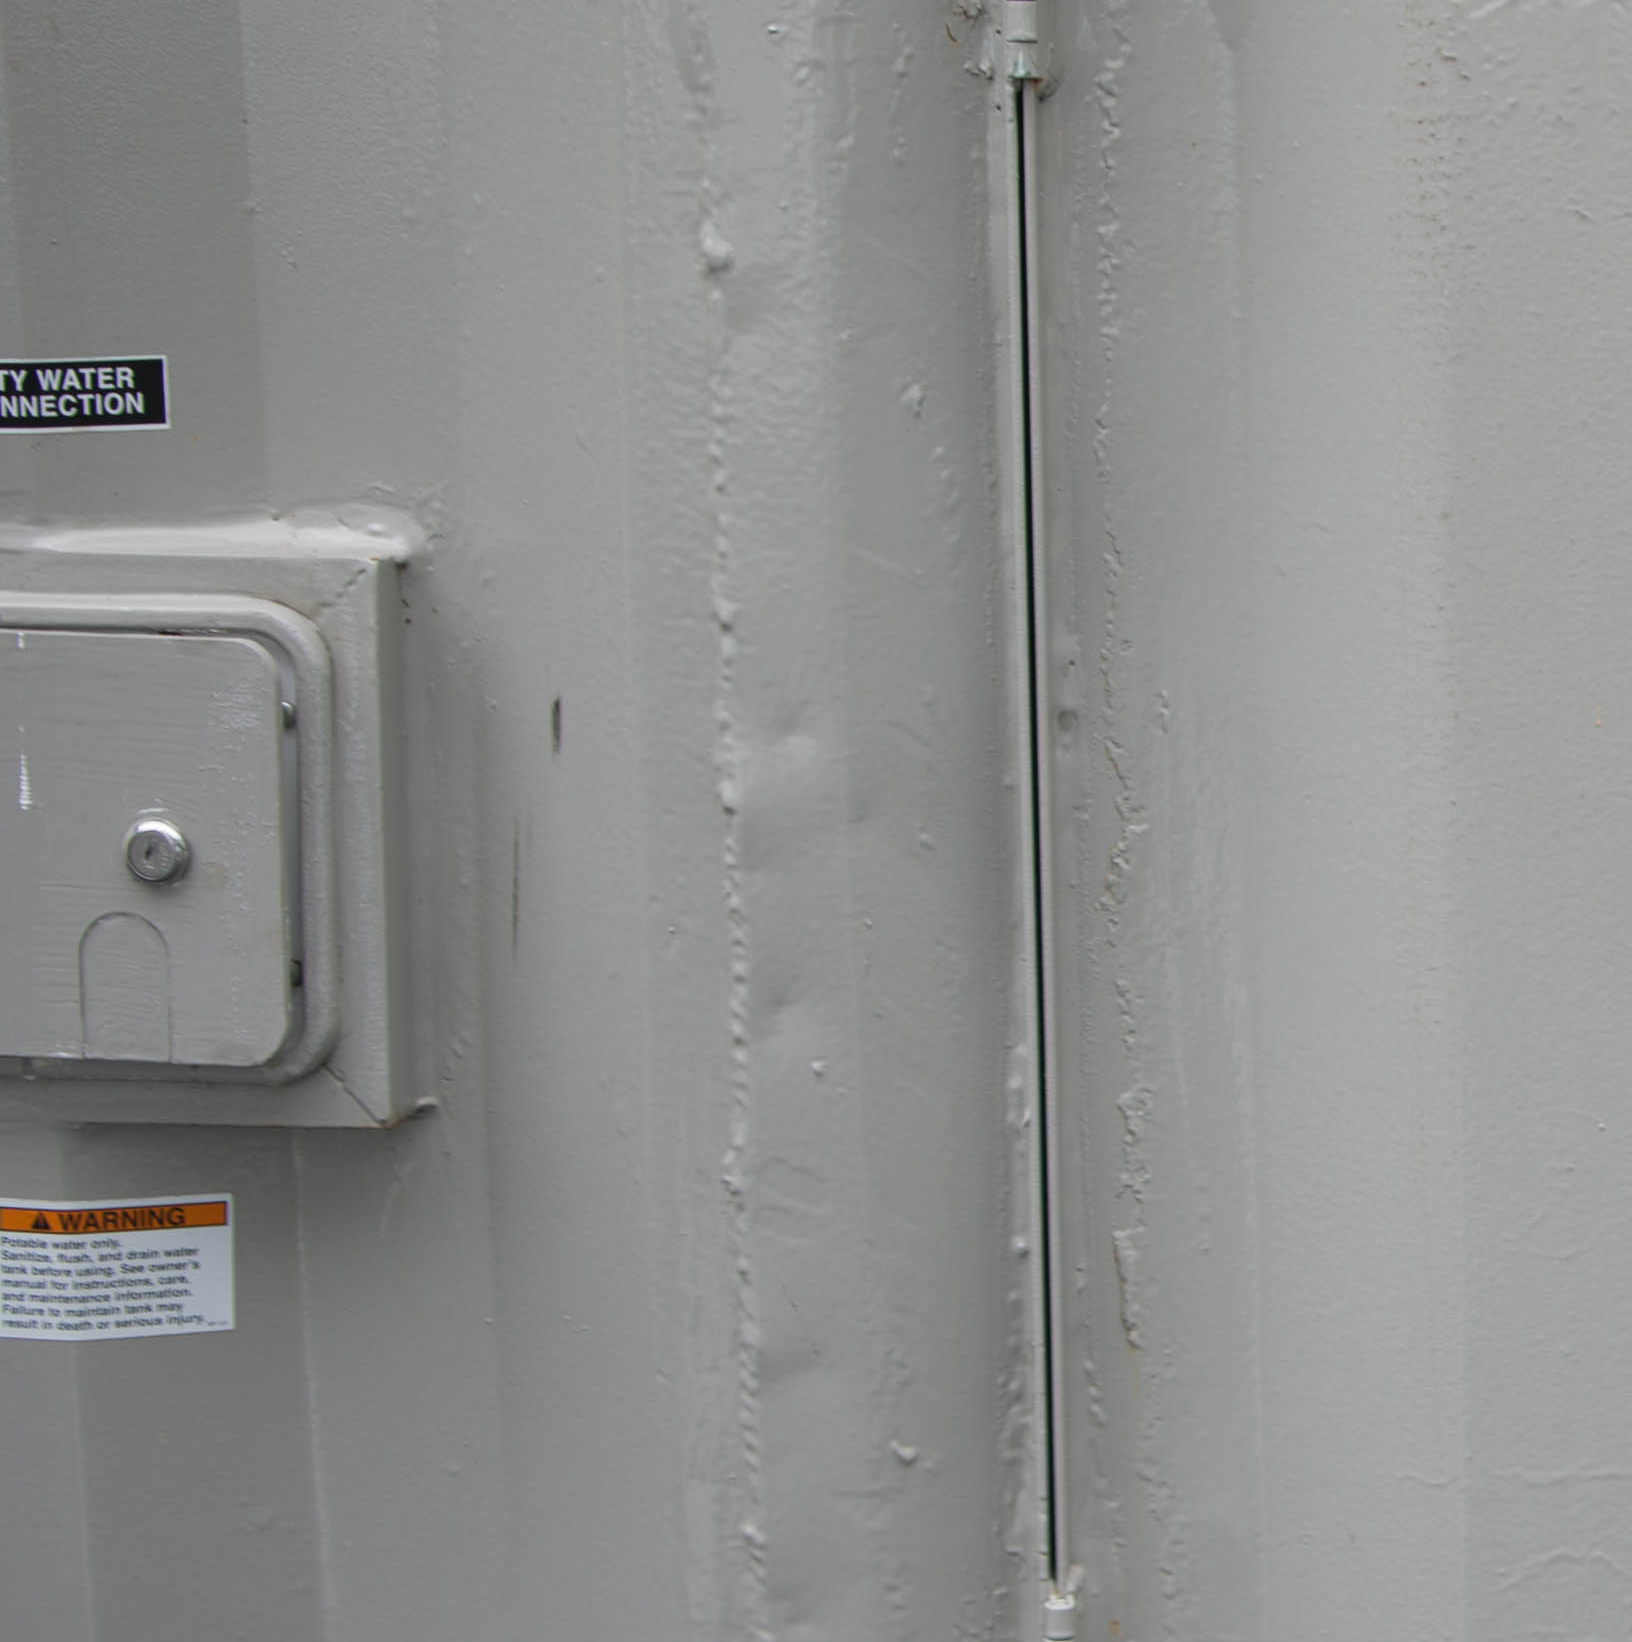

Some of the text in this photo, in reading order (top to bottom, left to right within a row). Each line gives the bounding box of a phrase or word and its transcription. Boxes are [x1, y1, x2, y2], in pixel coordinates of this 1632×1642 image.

[35, 366, 137, 392] WATER
[0, 391, 146, 418] NNECTION
[58, 1207, 186, 1232] WARNING
[1, 1236, 48, 1247] Potable
[51, 1240, 88, 1249] water
[97, 1252, 123, 1262] and
[126, 1249, 160, 1260] drain
[163, 1247, 200, 1257] water
[1, 1263, 28, 1274] tank
[31, 1265, 73, 1277] before
[120, 1263, 145, 1274] See
[1, 1279, 47, 1289] manual
[50, 1279, 69, 1290] for
[1, 1292, 26, 1302] and
[28, 1293, 111, 1304] maintenance
[1, 1303, 184, 1317] Failure to maintain tank may
[2, 1318, 39, 1329] result
[41, 1320, 53, 1330] in
[56, 1319, 93, 1331] death
[96, 1321, 111, 1330] or
[113, 1317, 163, 1328] serious
